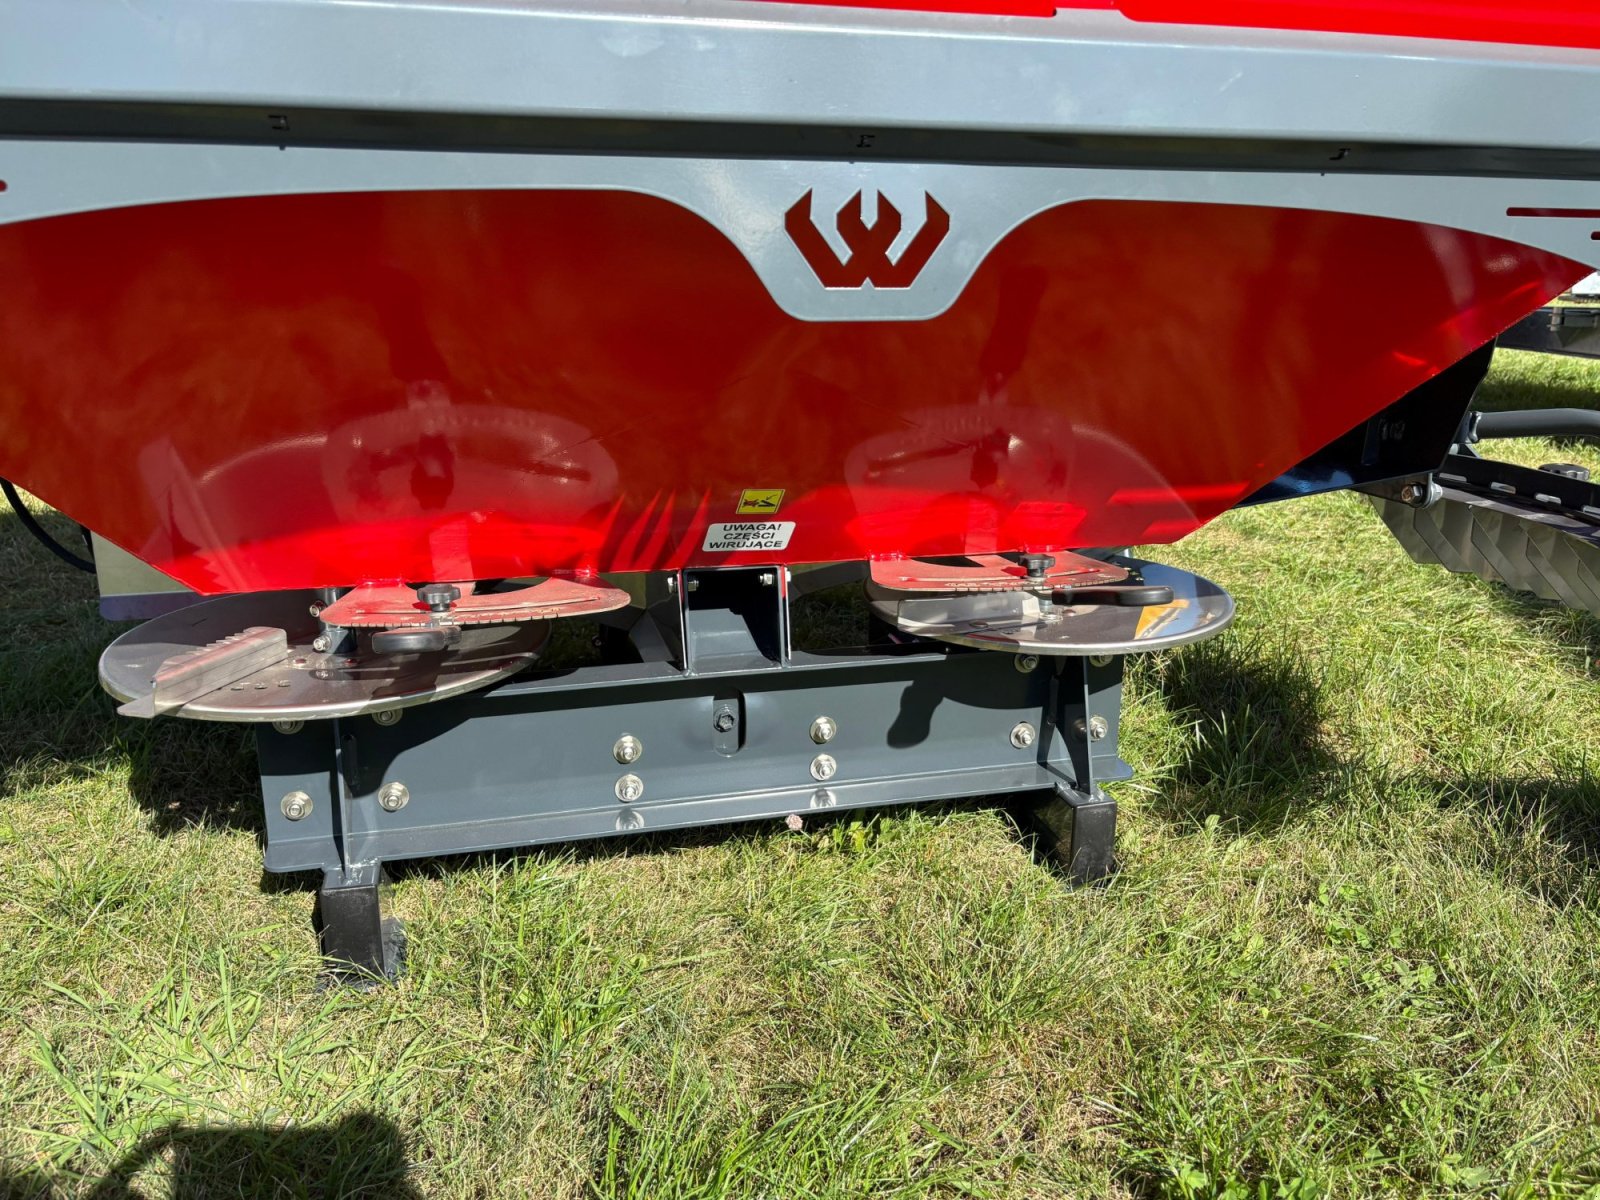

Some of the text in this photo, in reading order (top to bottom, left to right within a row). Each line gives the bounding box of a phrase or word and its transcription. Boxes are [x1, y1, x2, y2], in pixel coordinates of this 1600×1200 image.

[723, 523, 782, 531] UWAGA!
[723, 531, 775, 541] CZĘŚCI
[709, 541, 783, 550] WIRUJĄCE
